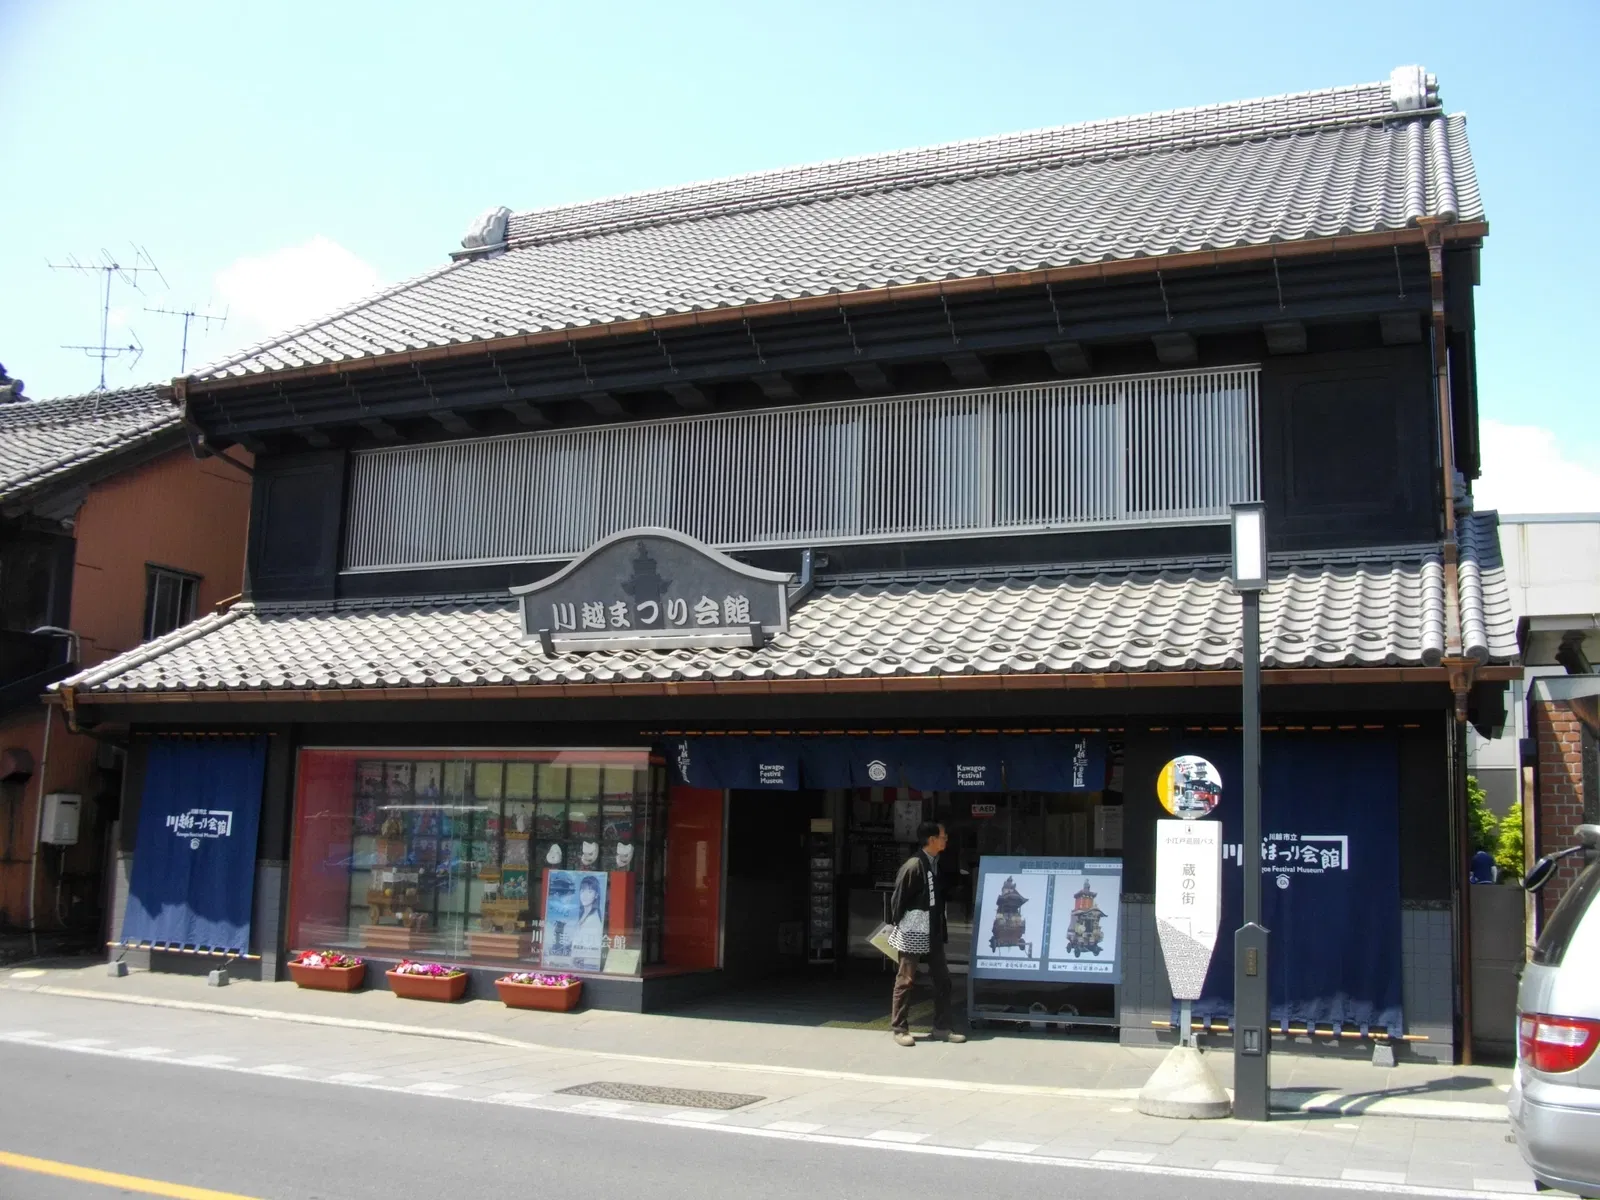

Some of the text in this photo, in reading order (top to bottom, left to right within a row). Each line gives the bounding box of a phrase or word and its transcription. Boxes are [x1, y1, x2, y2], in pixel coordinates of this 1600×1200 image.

[552, 595, 750, 630] 川越まつり会館
[957, 764, 986, 772] Kawagoe
[1272, 865, 1296, 873] Festival
[1297, 866, 1324, 874] Museum
[1182, 863, 1196, 905] 蔵の街
